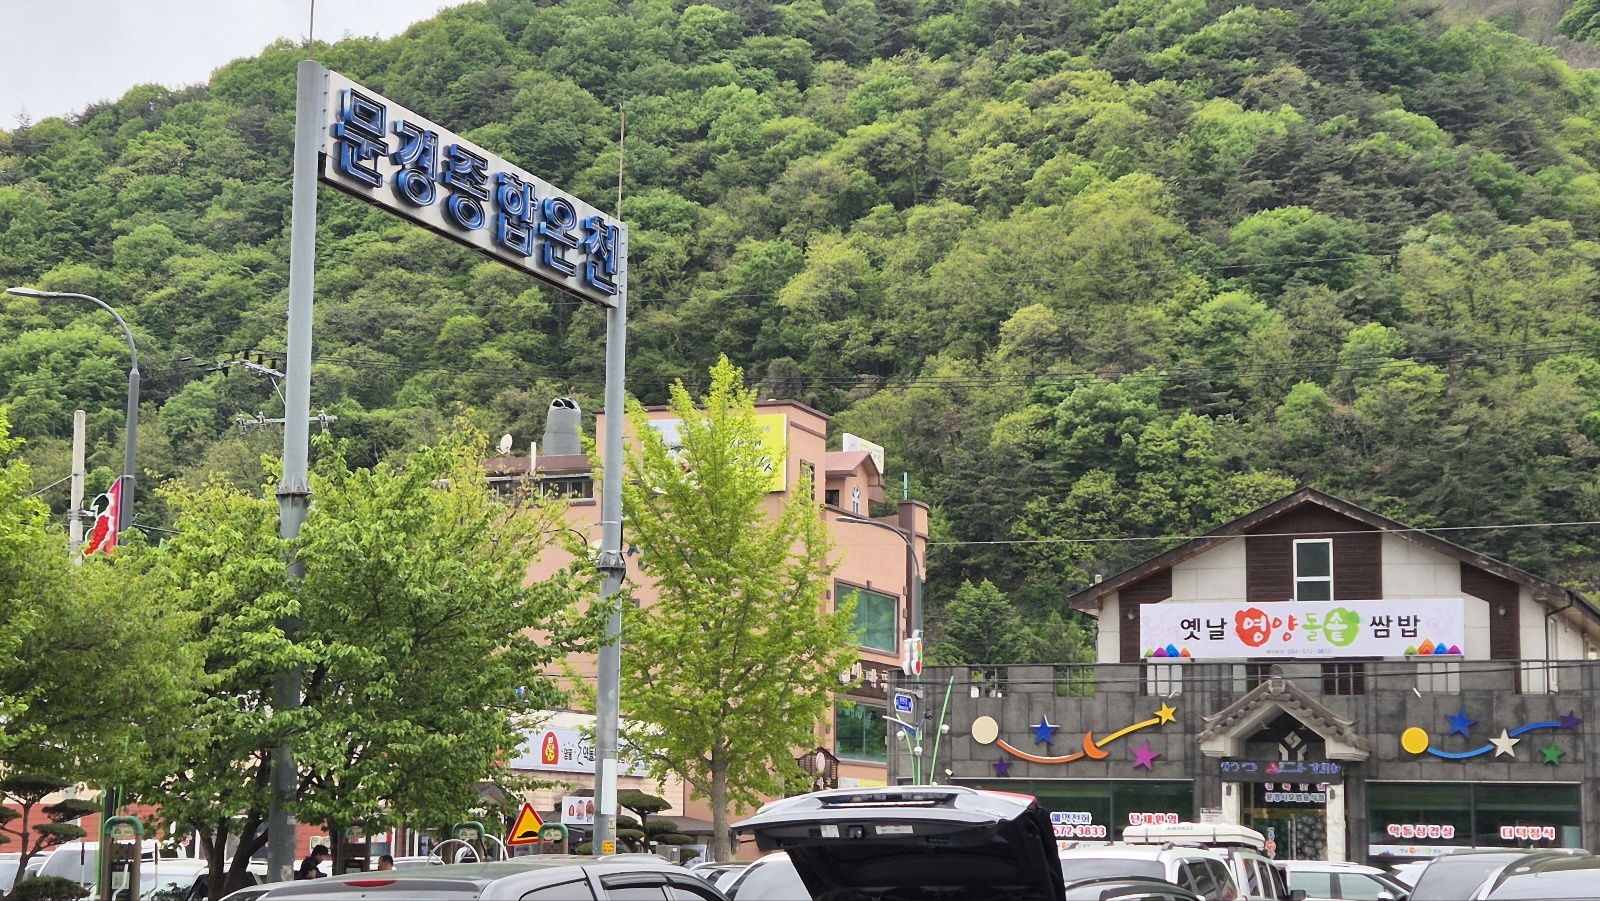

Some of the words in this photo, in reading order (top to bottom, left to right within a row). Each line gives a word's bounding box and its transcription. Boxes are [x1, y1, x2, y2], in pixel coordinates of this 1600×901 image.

[336, 89, 619, 296] 문경종합온천
[1180, 617, 1228, 641] 옛날
[1369, 614, 1421, 639] 쌈밥
[1130, 814, 1177, 824] 단체환영
[1501, 827, 1555, 839] 더덕정식
